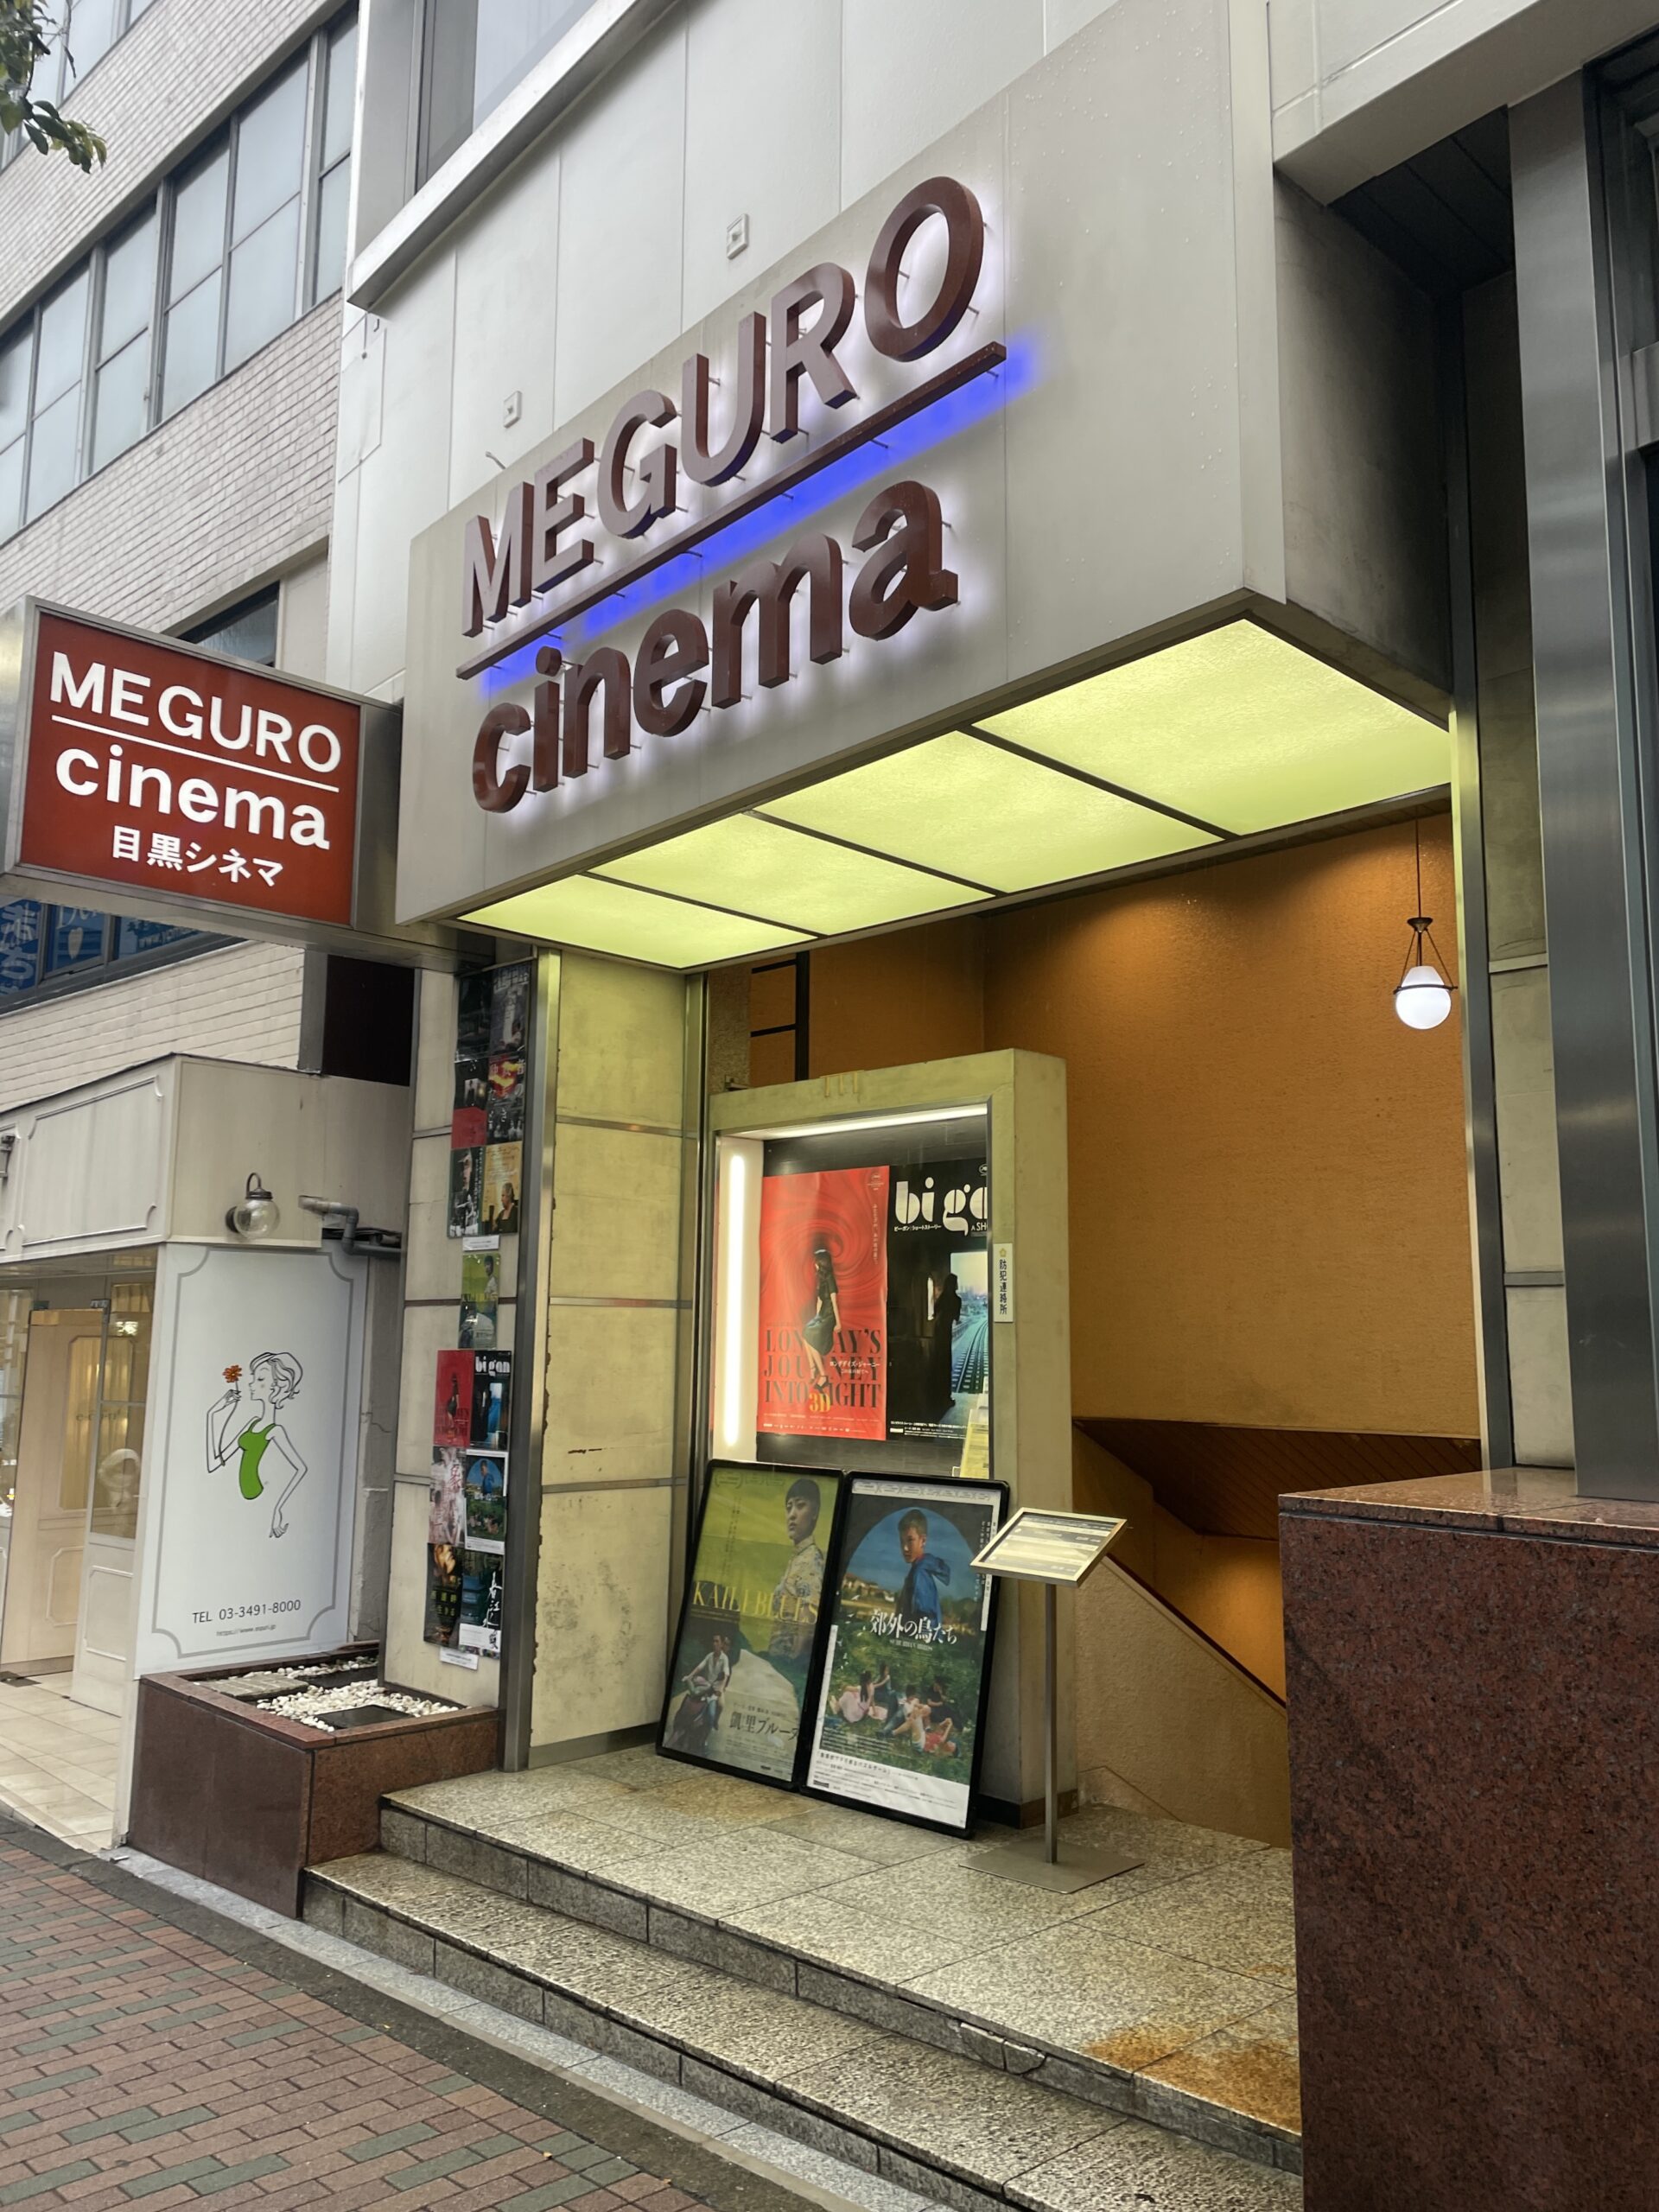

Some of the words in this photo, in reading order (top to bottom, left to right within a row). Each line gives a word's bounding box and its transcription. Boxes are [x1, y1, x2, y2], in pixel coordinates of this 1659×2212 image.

[461, 175, 985, 638] MEGURO
[472, 480, 959, 814] cinema
[49, 651, 342, 774] MEGURO
[55, 744, 330, 850] cinema
[112, 824, 284, 887] 目黒シネマ
[976, 1222, 988, 1231] SH
[999, 1258, 1007, 1315] 防犯連絡所
[832, 1328, 881, 1354] AY'S
[475, 1356, 511, 1376] bigan
[764, 1354, 881, 1382] JOUNEY
[809, 1392, 831, 1413] 3D
[192, 1611, 213, 1624] TEL
[219, 1599, 302, 1620] 03-3491-8000
[693, 1581, 748, 1613] KAILI
[754, 1590, 818, 1625] BLUES
[870, 1608, 957, 1644] 郊外の鳥たち
